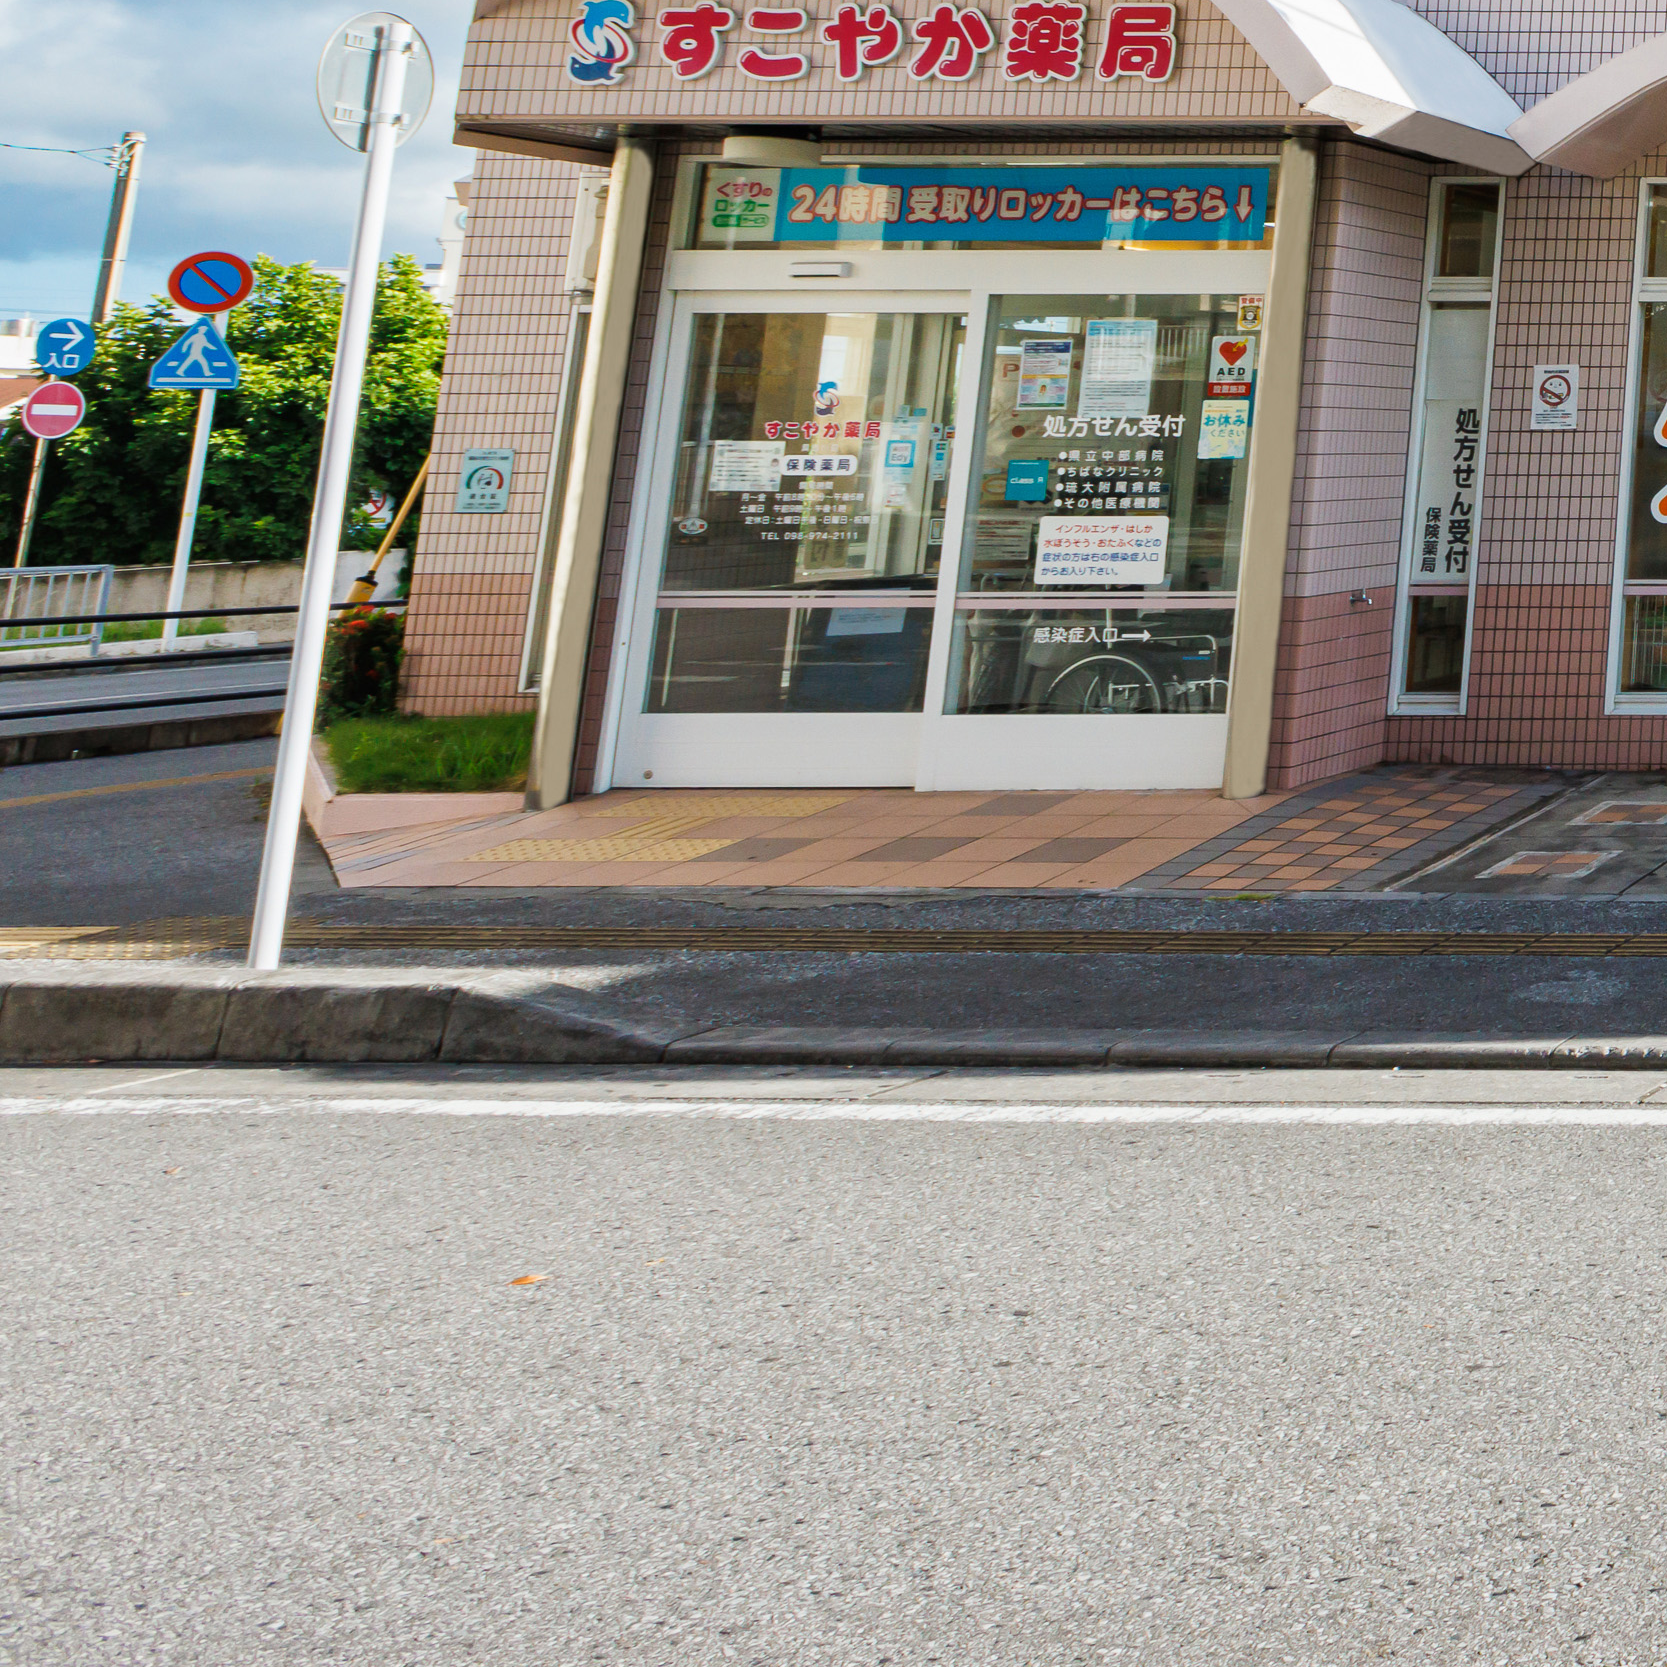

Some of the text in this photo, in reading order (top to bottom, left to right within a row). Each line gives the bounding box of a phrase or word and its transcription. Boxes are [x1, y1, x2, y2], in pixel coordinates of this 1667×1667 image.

[657, 0, 1178, 83] すこやか薬局
[789, 183, 1230, 225] 24時間 受取りロッカーはこちら
[43, 352, 80, 369] 入口
[1216, 367, 1246, 376] AED
[1042, 414, 1187, 438] 処方せん受付
[1203, 413, 1246, 428] お休み
[764, 420, 881, 440] すこやか薬局
[1210, 428, 1246, 438] ください
[786, 458, 851, 472] 保険薬局
[1067, 466, 1163, 477] ちばなクリニック
[1444, 407, 1481, 574] 処方せん受付
[761, 532, 780, 540] TEL
[1055, 524, 1154, 534] インフルエンザ・はしか
[1043, 538, 1162, 548] 水ぼうそう・おたふくなどの
[1420, 506, 1442, 573] 保険薬局
[1042, 552, 1160, 562] 症状の方は右の感染症入口
[1041, 566, 1119, 576] からお入り下さい。
[1033, 626, 1118, 644] 感染症入口
